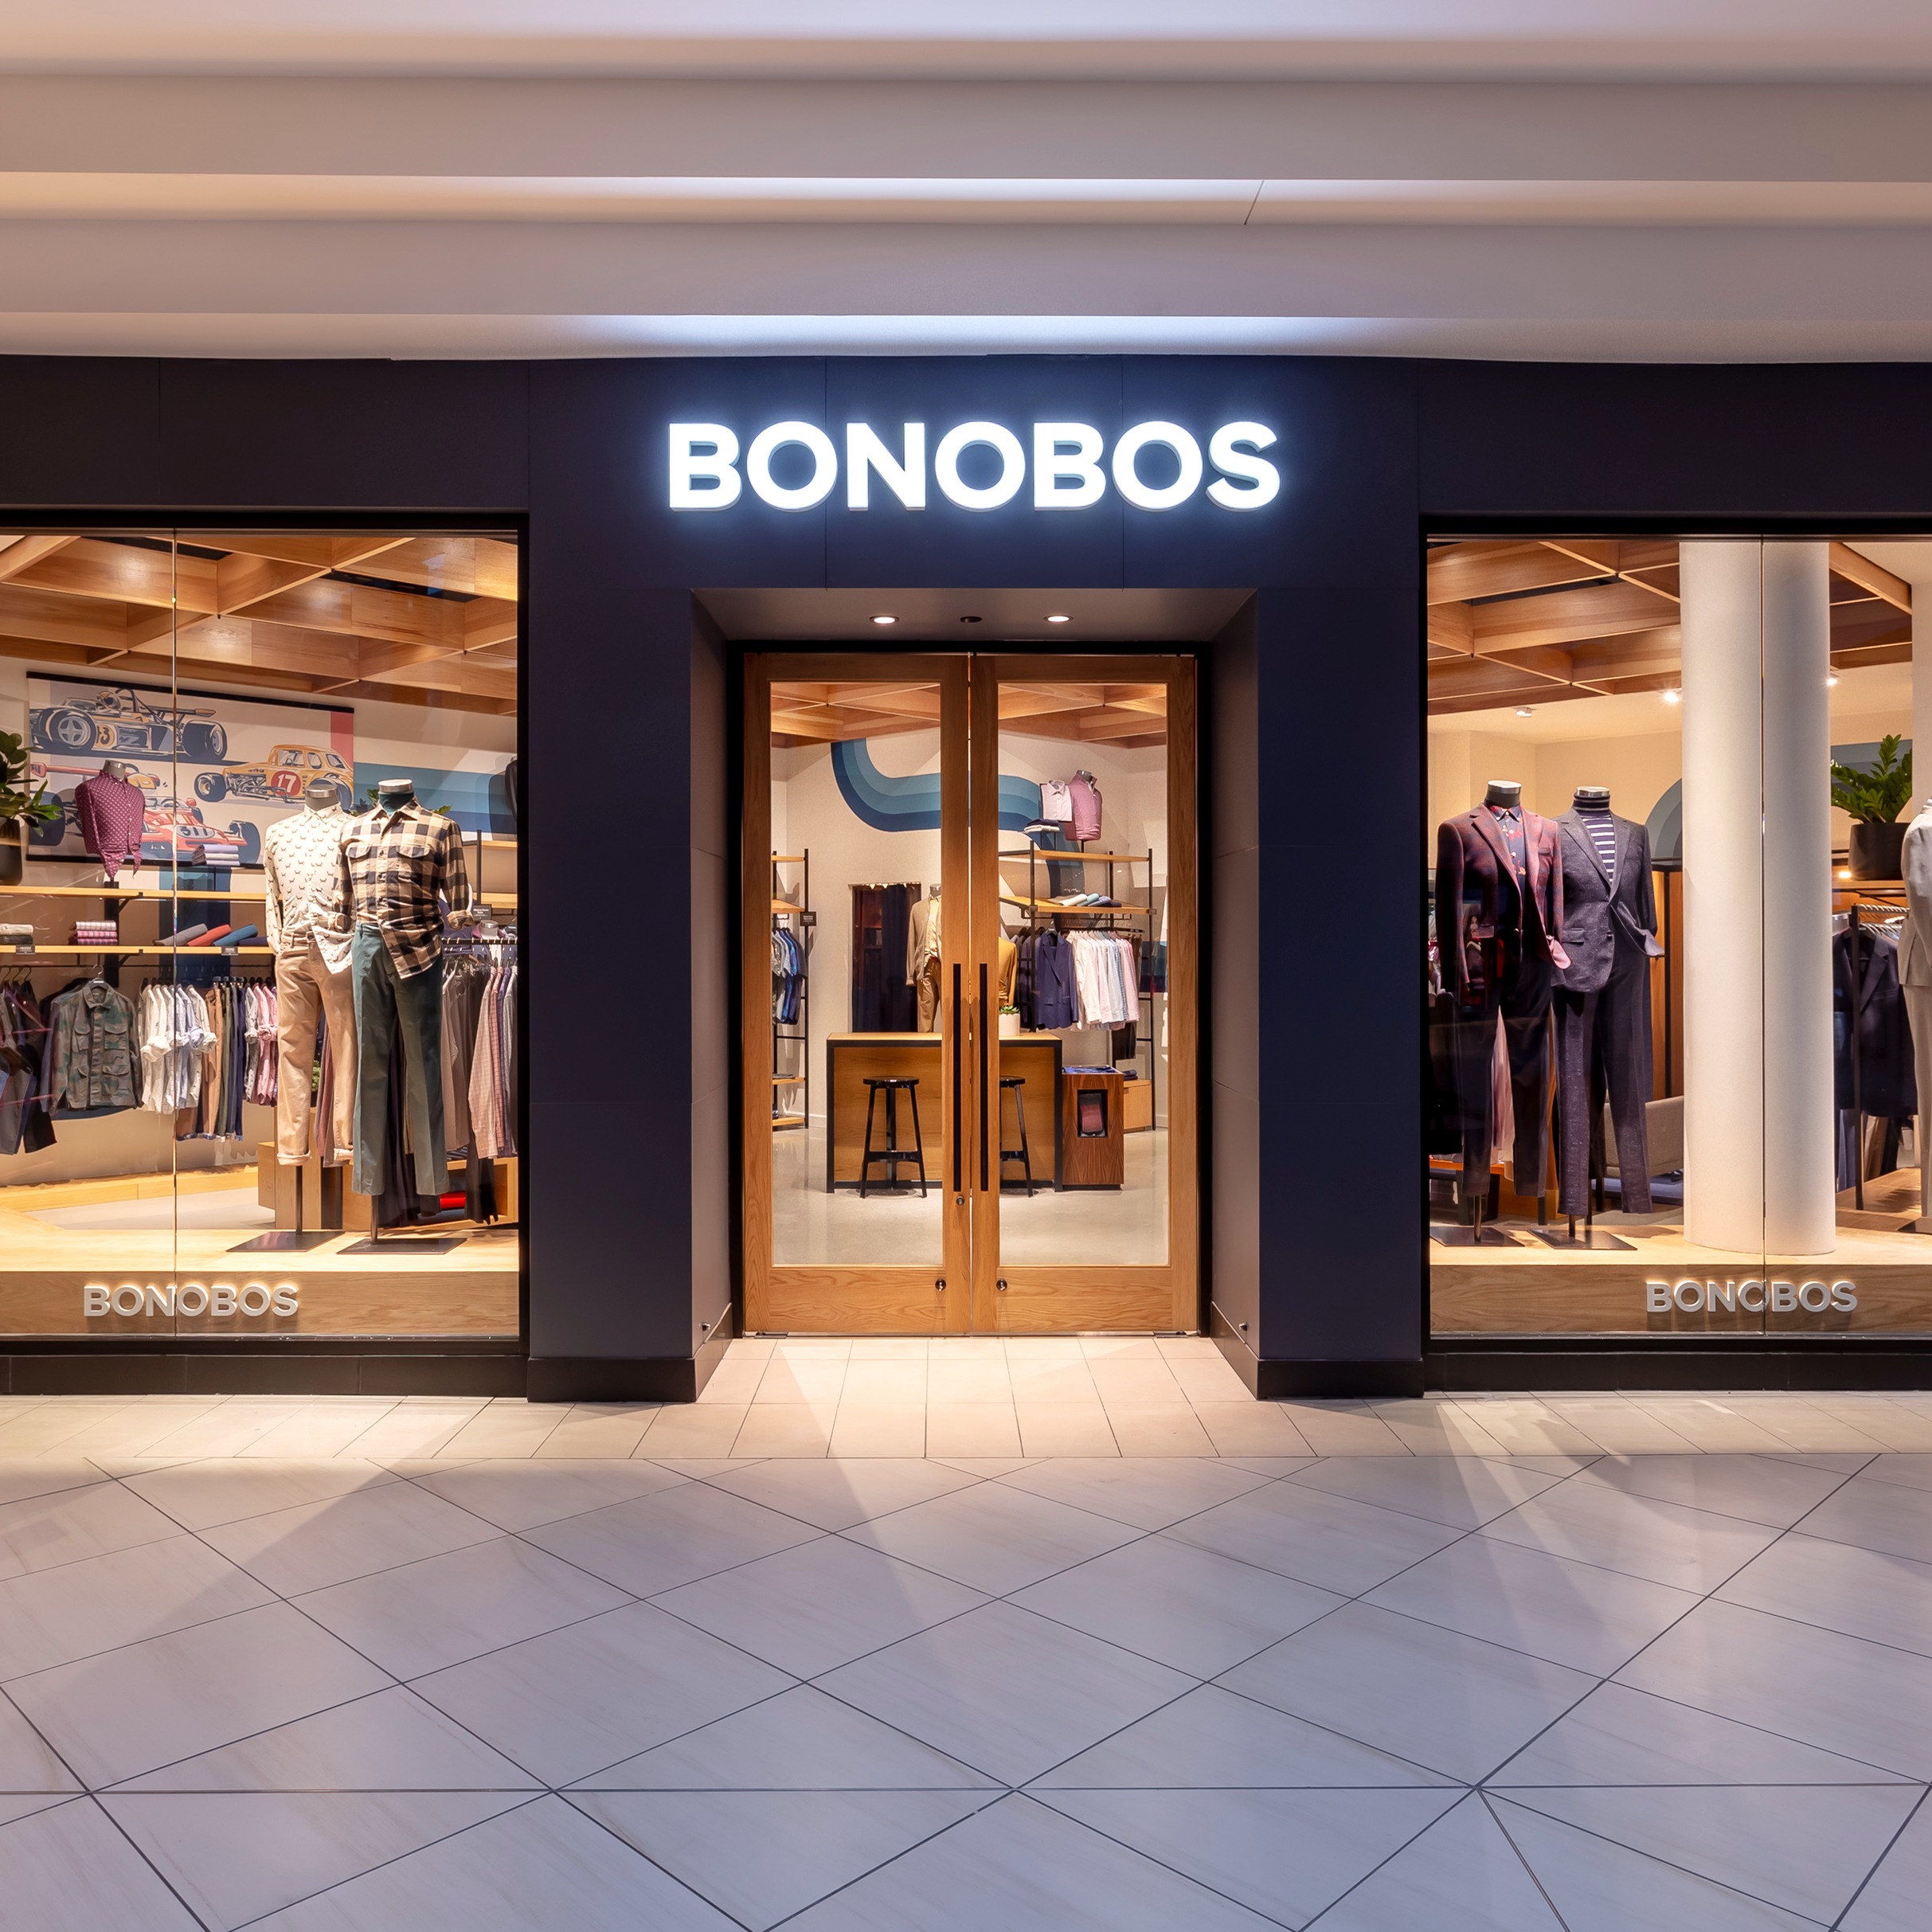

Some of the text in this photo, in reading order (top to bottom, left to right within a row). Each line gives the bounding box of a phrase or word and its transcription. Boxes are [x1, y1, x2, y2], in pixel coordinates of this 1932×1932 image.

[668, 420, 1281, 512] BONOBOS
[278, 773, 297, 793] 17
[83, 1284, 299, 1316] BONOBOS
[1646, 1280, 1858, 1312] BONOBOS
